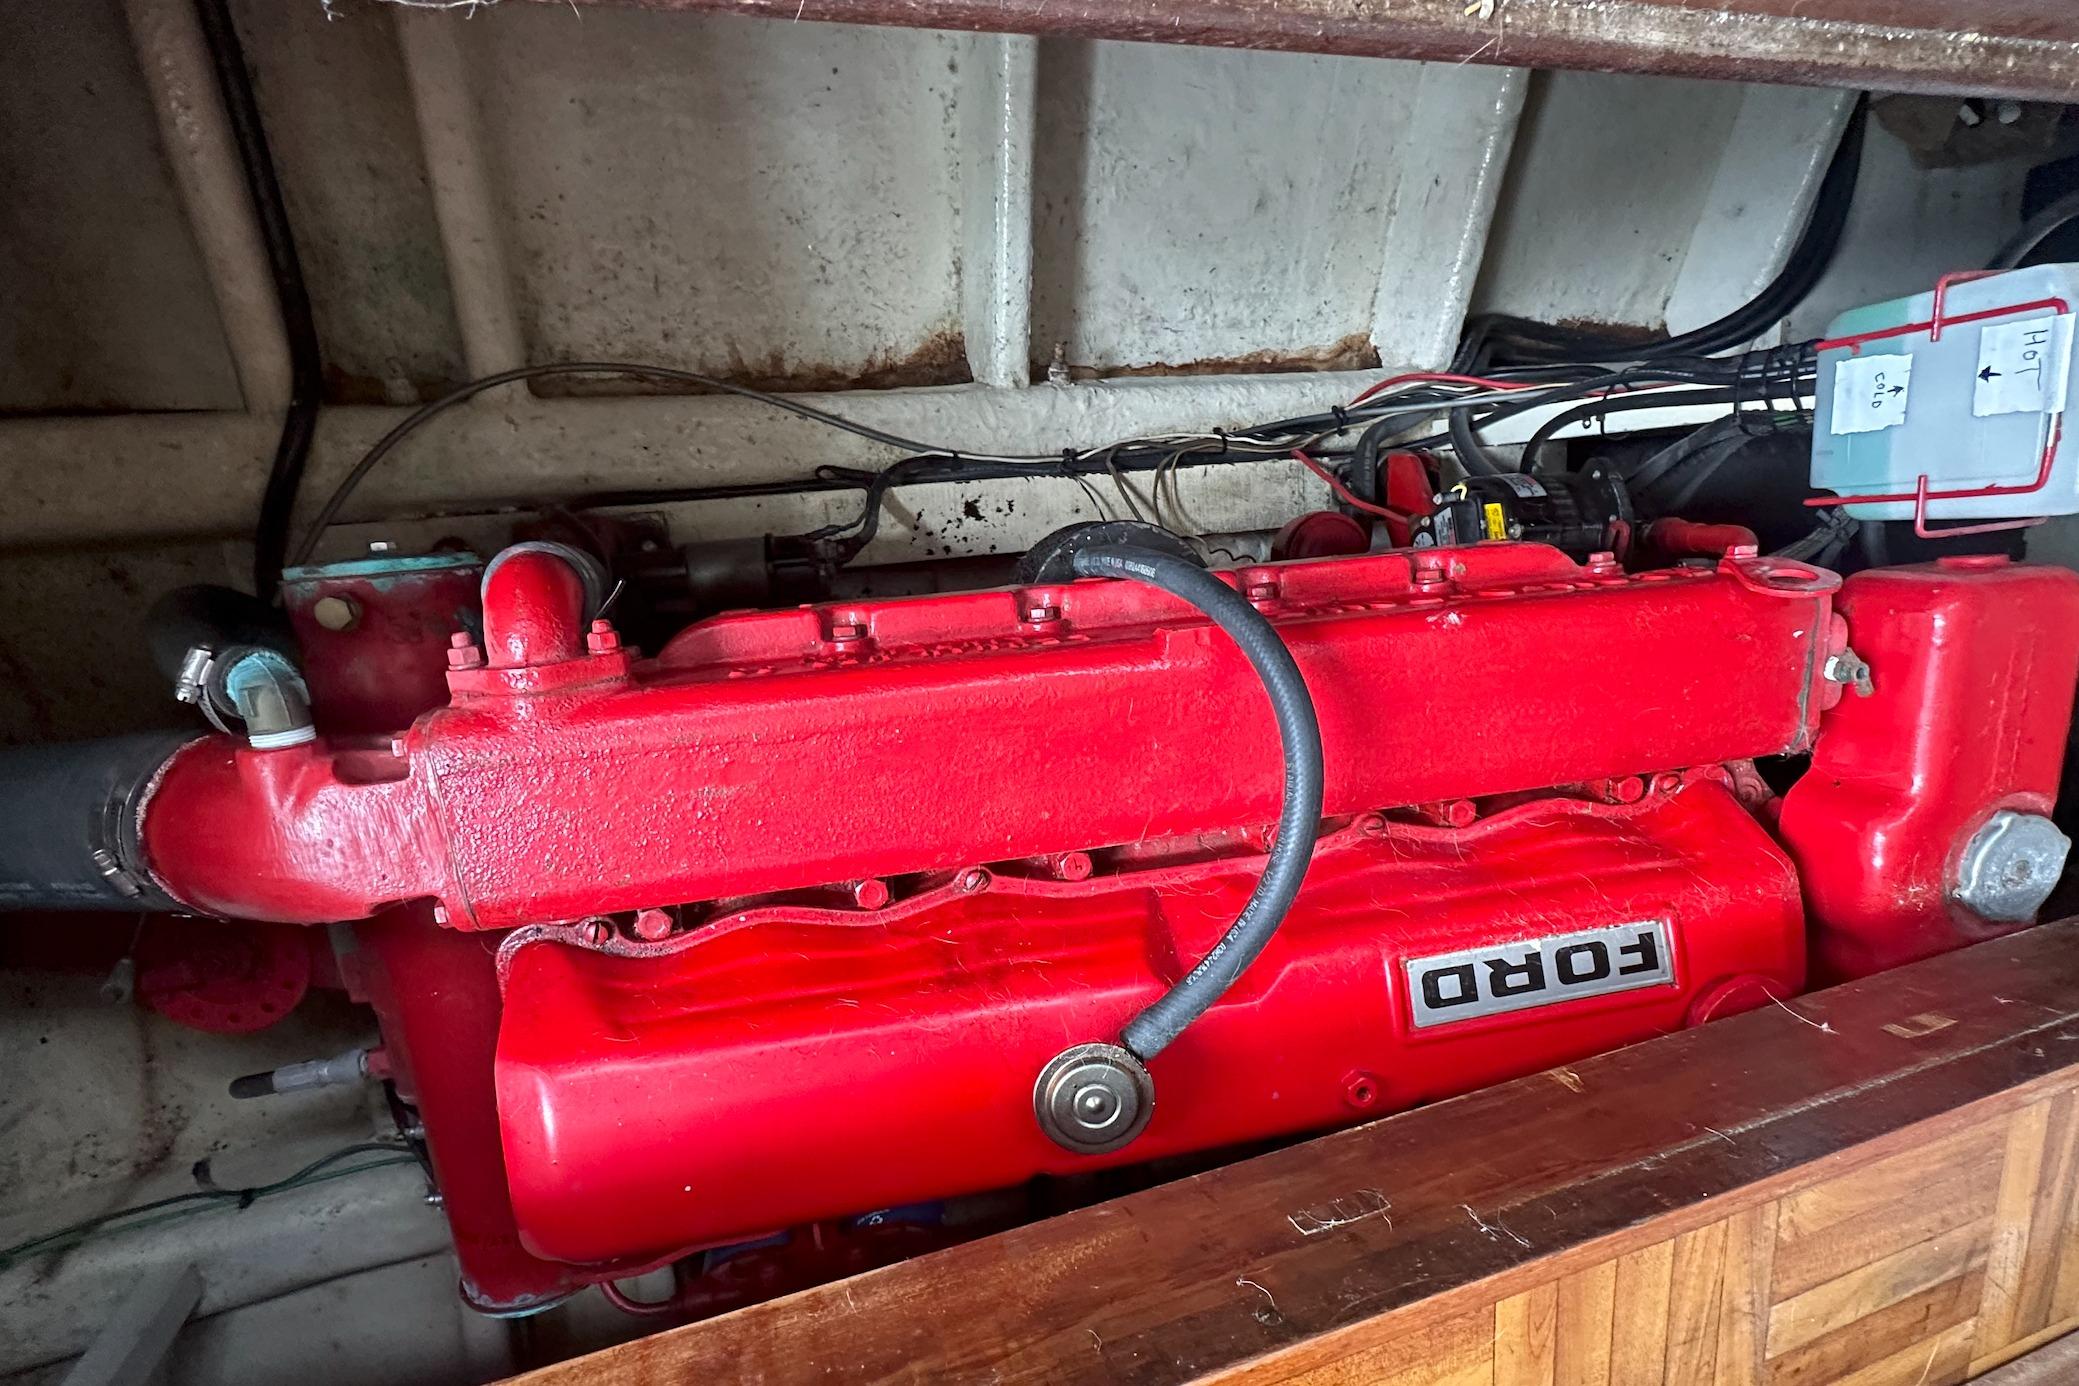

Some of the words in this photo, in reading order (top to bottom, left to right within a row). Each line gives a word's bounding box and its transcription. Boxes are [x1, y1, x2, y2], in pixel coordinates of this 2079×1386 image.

[2015, 329, 2048, 391] HOT
[1871, 372, 1885, 409] COLD
[1243, 899, 1260, 919] MADE
[1226, 925, 1241, 942] USA
[1421, 931, 1659, 1009] FORD
